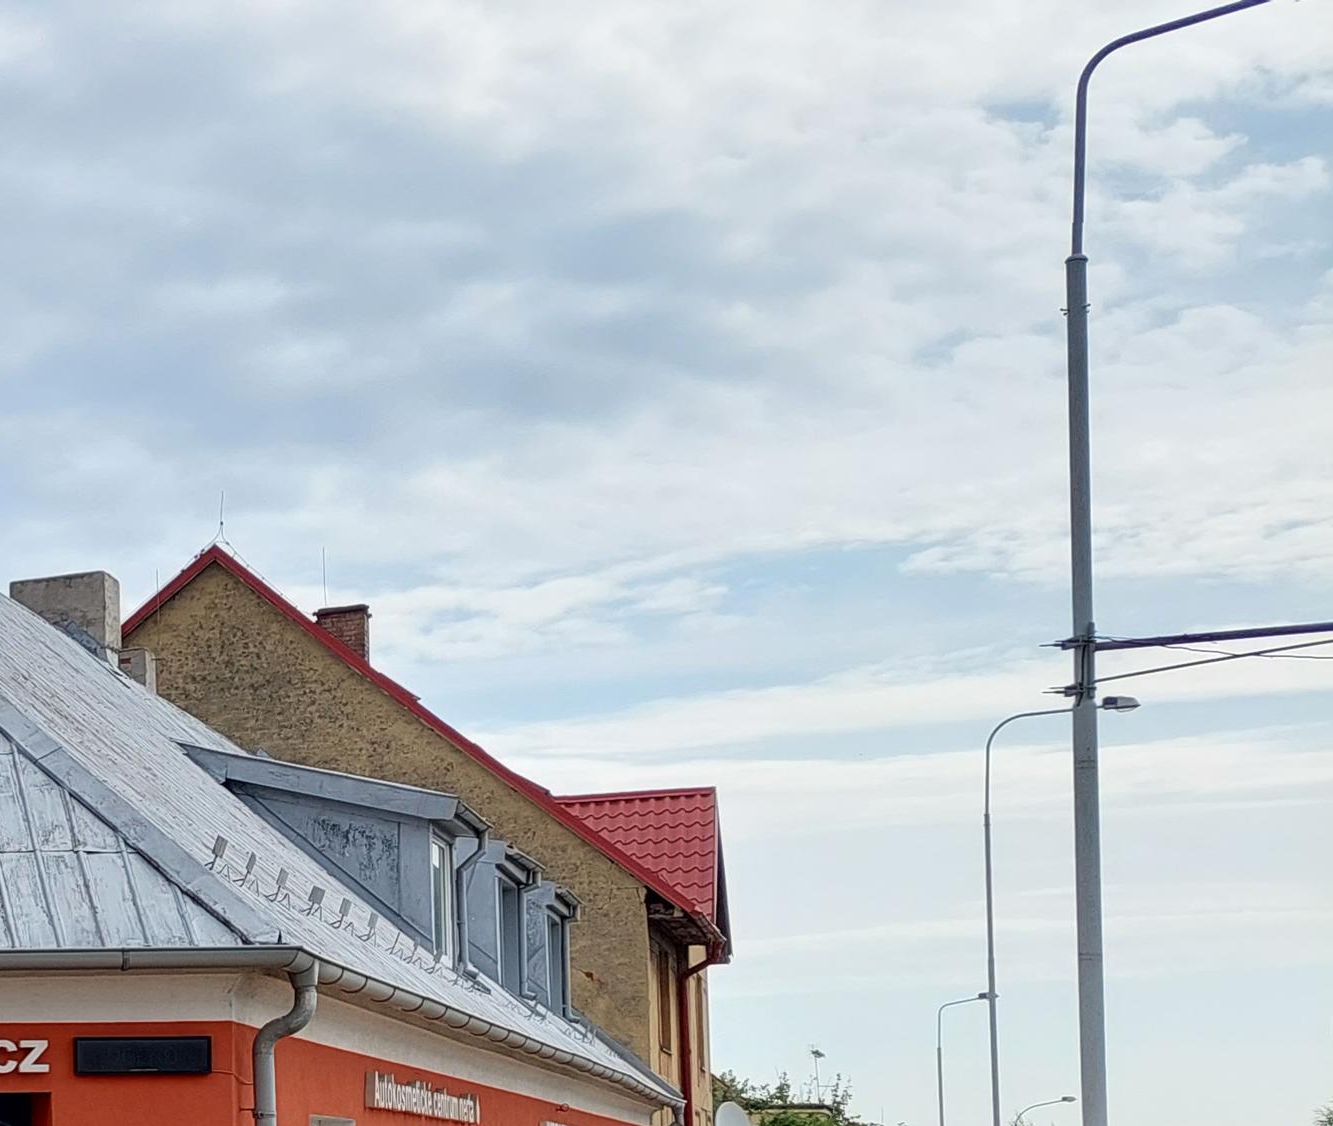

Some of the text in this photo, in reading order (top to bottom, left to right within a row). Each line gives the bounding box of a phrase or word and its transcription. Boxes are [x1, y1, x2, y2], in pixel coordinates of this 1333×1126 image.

[374, 1071, 475, 1123] Autokosmetické centrum nerta
